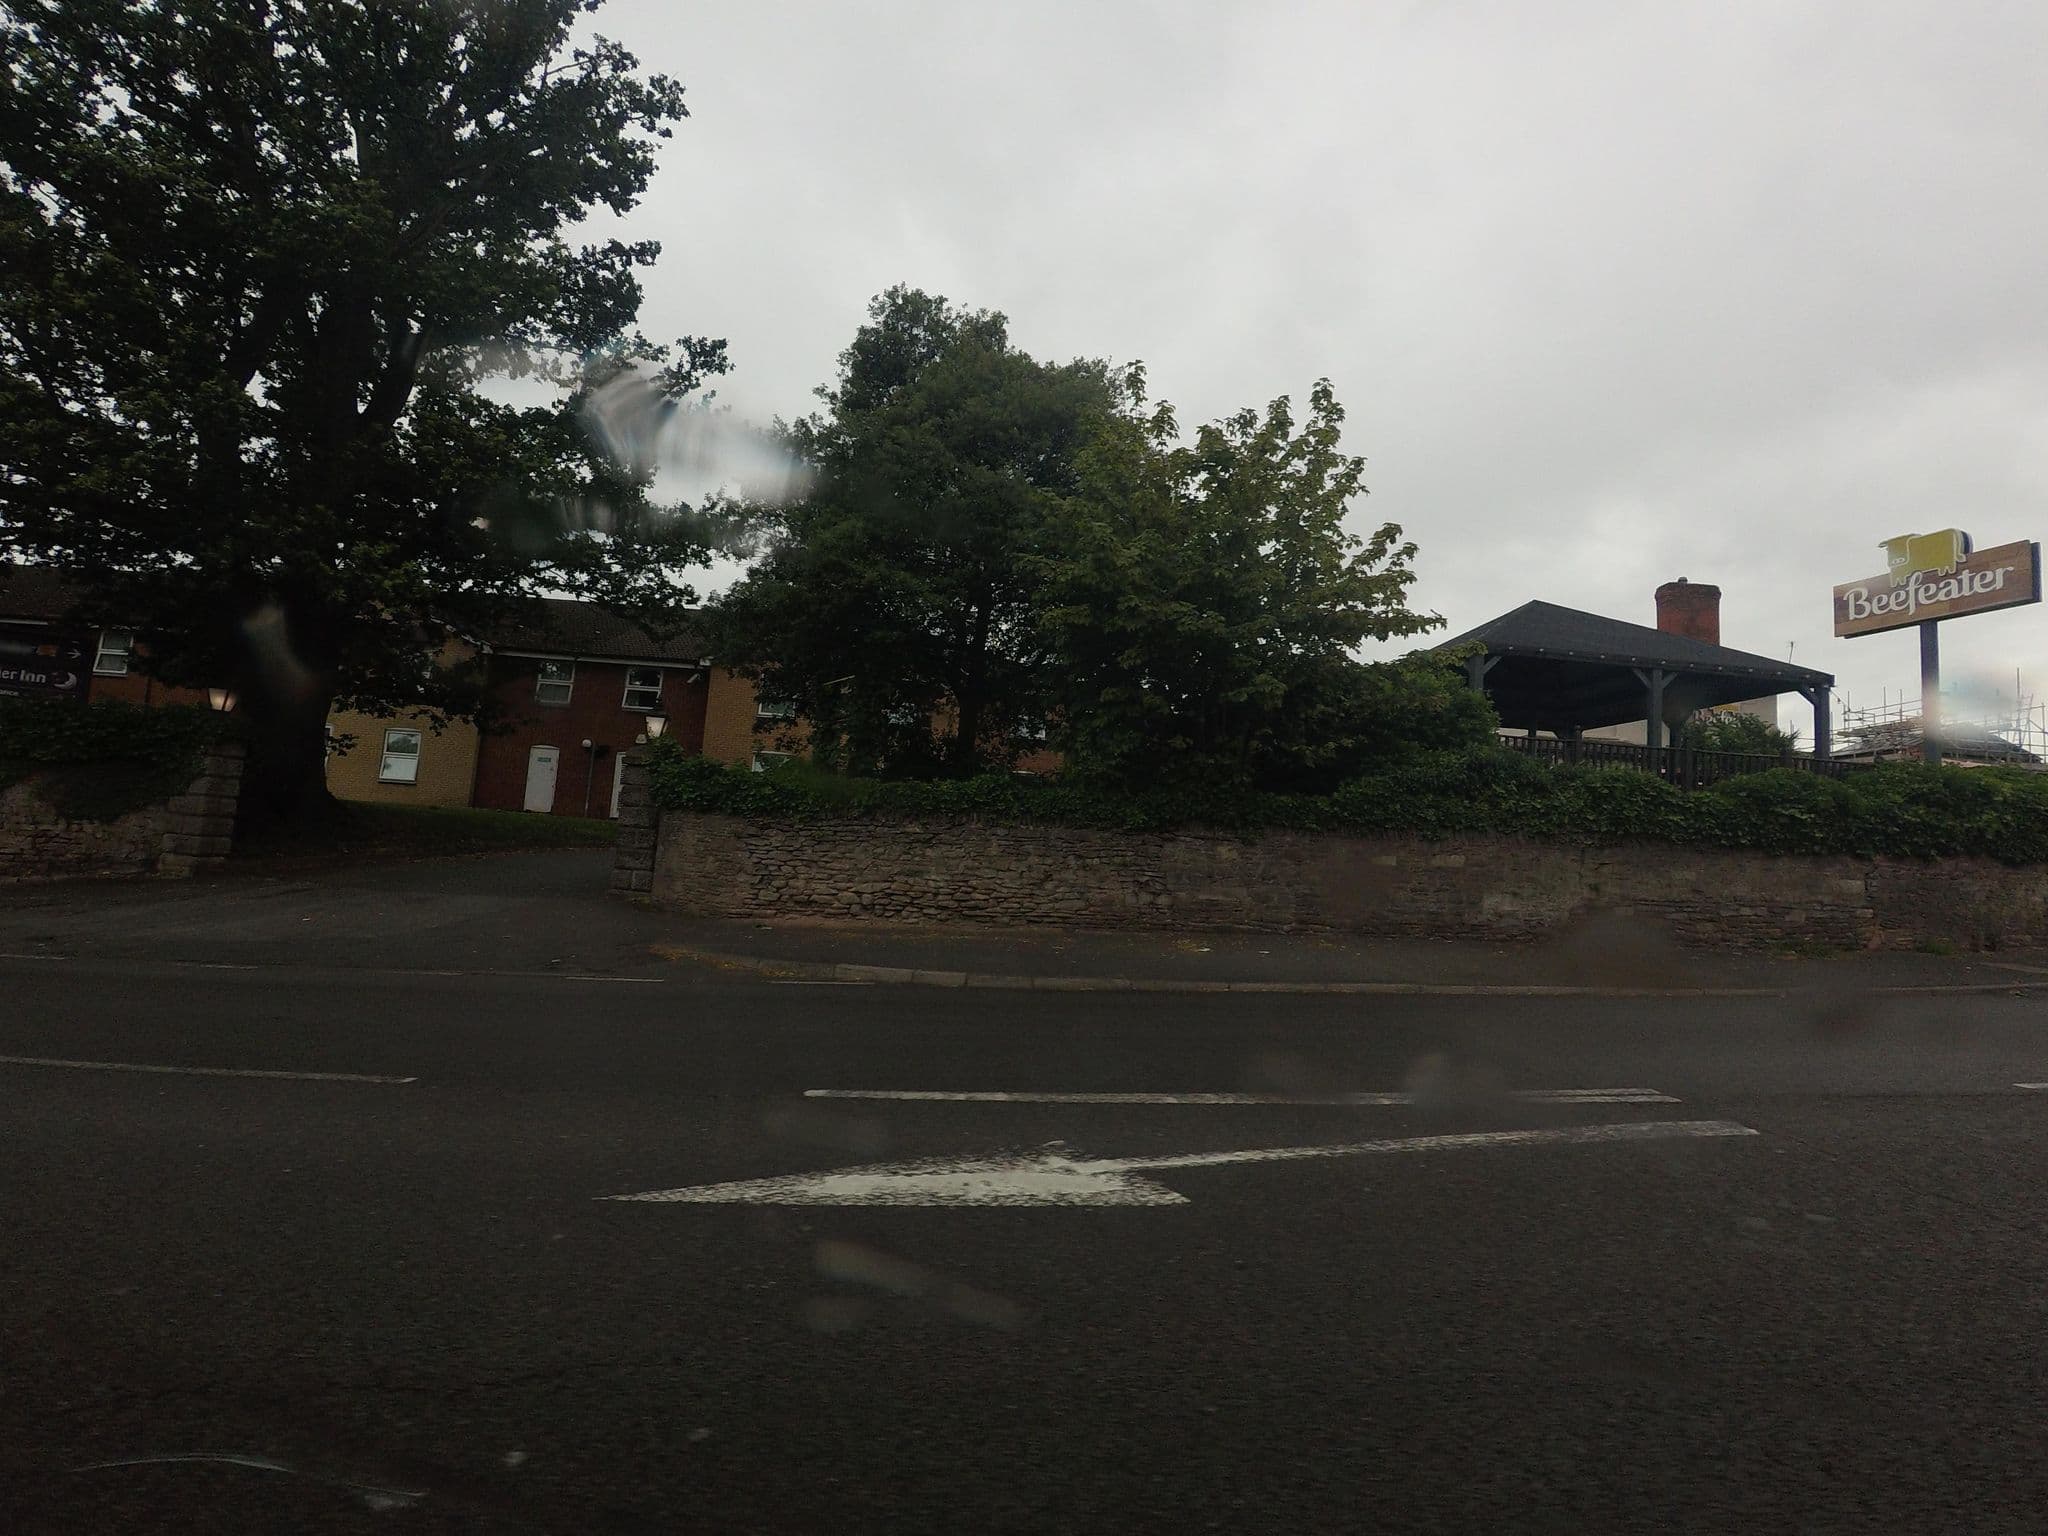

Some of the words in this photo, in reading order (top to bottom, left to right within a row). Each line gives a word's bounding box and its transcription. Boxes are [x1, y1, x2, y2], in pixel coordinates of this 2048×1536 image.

[1843, 565, 2015, 621] Beefeater
[0, 668, 18, 680] er
[19, 669, 46, 684] Inn
